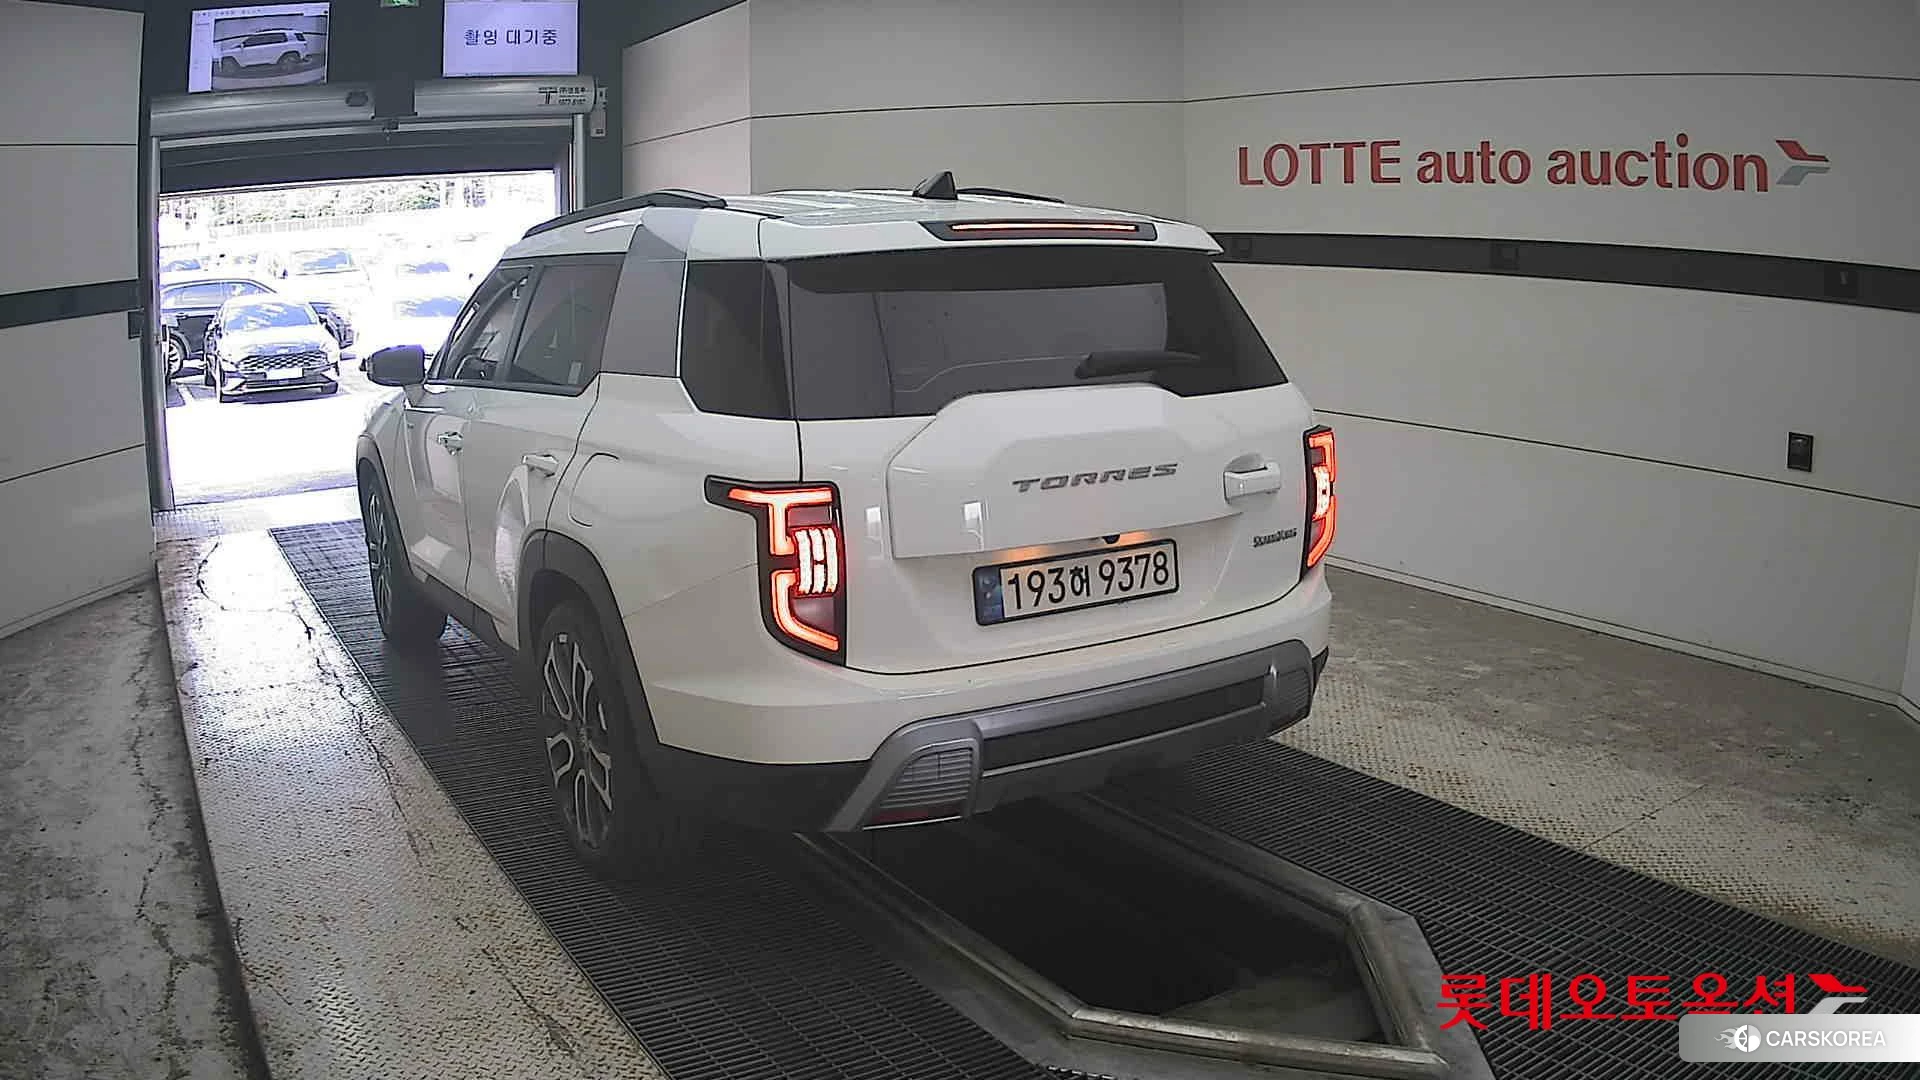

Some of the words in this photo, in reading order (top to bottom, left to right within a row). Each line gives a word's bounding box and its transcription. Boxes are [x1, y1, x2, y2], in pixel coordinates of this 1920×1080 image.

[506, 29, 558, 46] 대기중
[1239, 140, 1401, 187] LOTTE
[1416, 140, 1532, 185] auto
[1547, 133, 1769, 192] auction
[1012, 463, 1178, 493] TORRES
[1007, 565, 1091, 610] 193허
[1099, 550, 1169, 595] 9378
